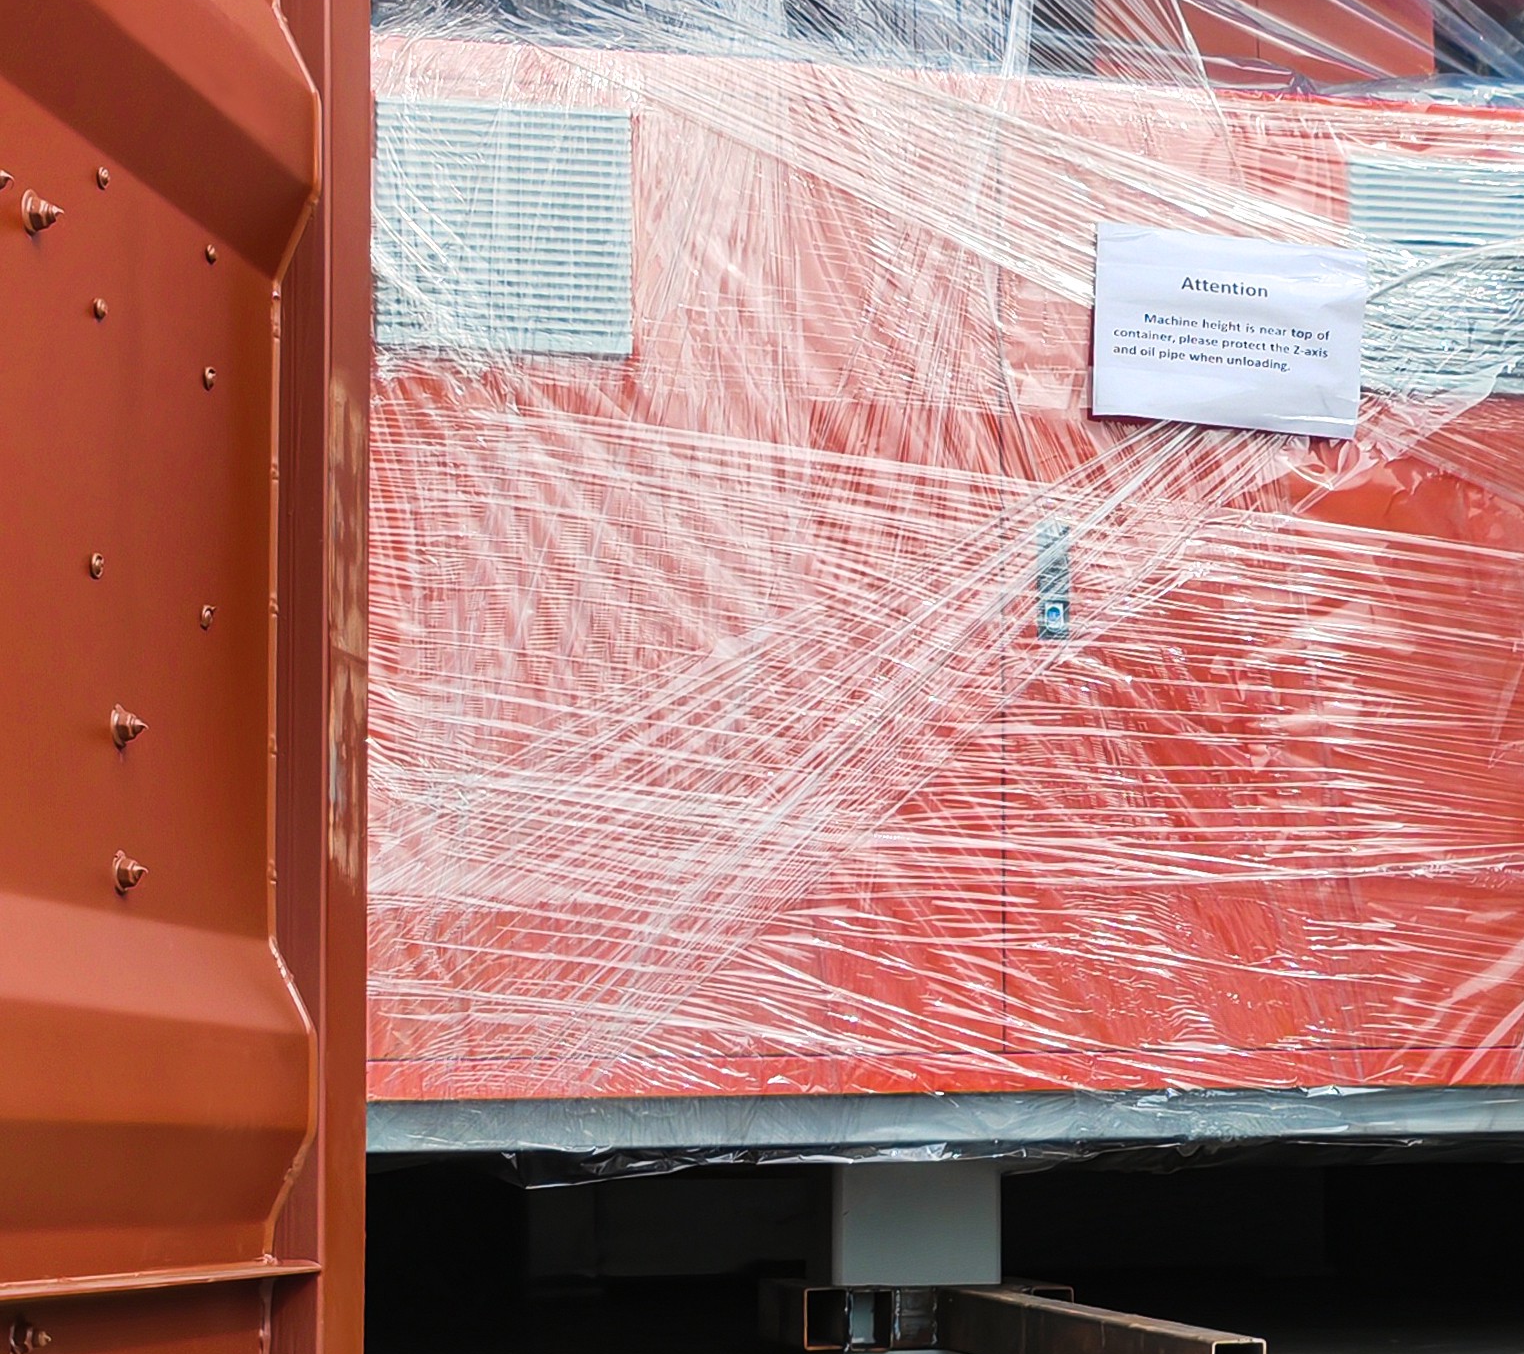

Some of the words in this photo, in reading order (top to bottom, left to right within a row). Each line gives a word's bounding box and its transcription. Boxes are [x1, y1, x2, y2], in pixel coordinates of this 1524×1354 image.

[1181, 276, 1269, 298] Attention
[1144, 313, 1198, 328] Machine
[1202, 318, 1240, 333] height
[1246, 323, 1255, 334] is
[1259, 326, 1287, 337] near
[1291, 328, 1313, 341] top
[1317, 330, 1330, 341] of
[1113, 328, 1176, 344] container,
[1179, 334, 1218, 347] please
[1222, 339, 1266, 351] protect
[1270, 343, 1290, 354] the
[1293, 344, 1328, 359] Z-axis
[1113, 345, 1137, 355] and
[1140, 346, 1155, 357] oil
[1158, 349, 1186, 361] pipe
[1189, 352, 1224, 364] when
[1227, 356, 1291, 373] unloading.
